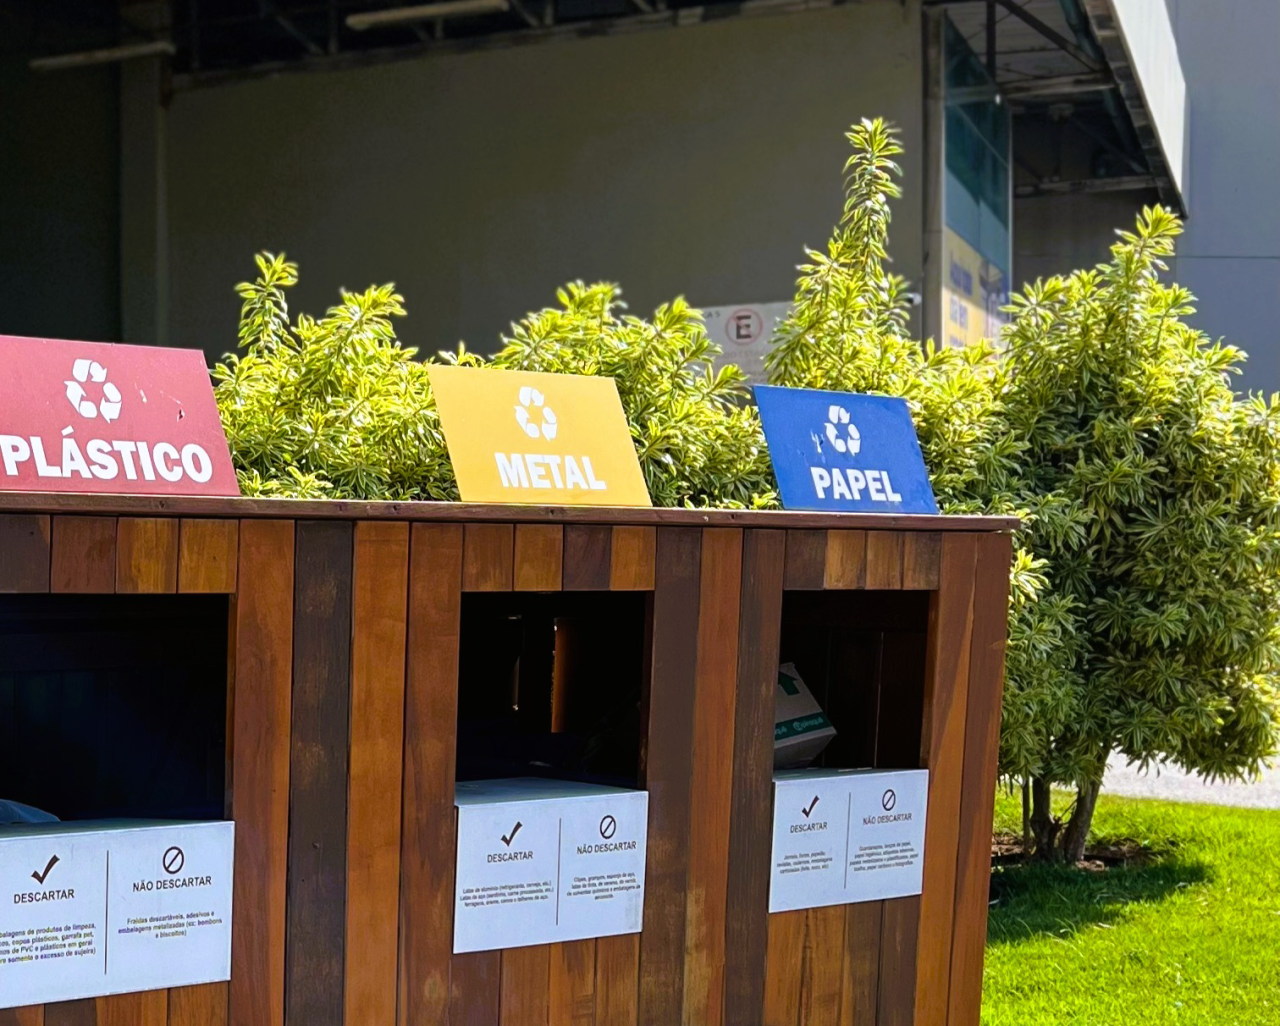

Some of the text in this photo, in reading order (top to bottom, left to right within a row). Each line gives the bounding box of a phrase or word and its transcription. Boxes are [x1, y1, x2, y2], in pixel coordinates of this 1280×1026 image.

[494, 452, 607, 490] METAL
[810, 466, 902, 501] PAPEL
[862, 813, 913, 826] NÃO DESCARTAR
[789, 822, 828, 834] DESCARTAR
[577, 841, 637, 855] NÃO DESCARTAR
[487, 851, 534, 863] DESCARTAR
[132, 876, 212, 893] NÃO DESCARTAR
[13, 889, 75, 904] DESCARTAR
